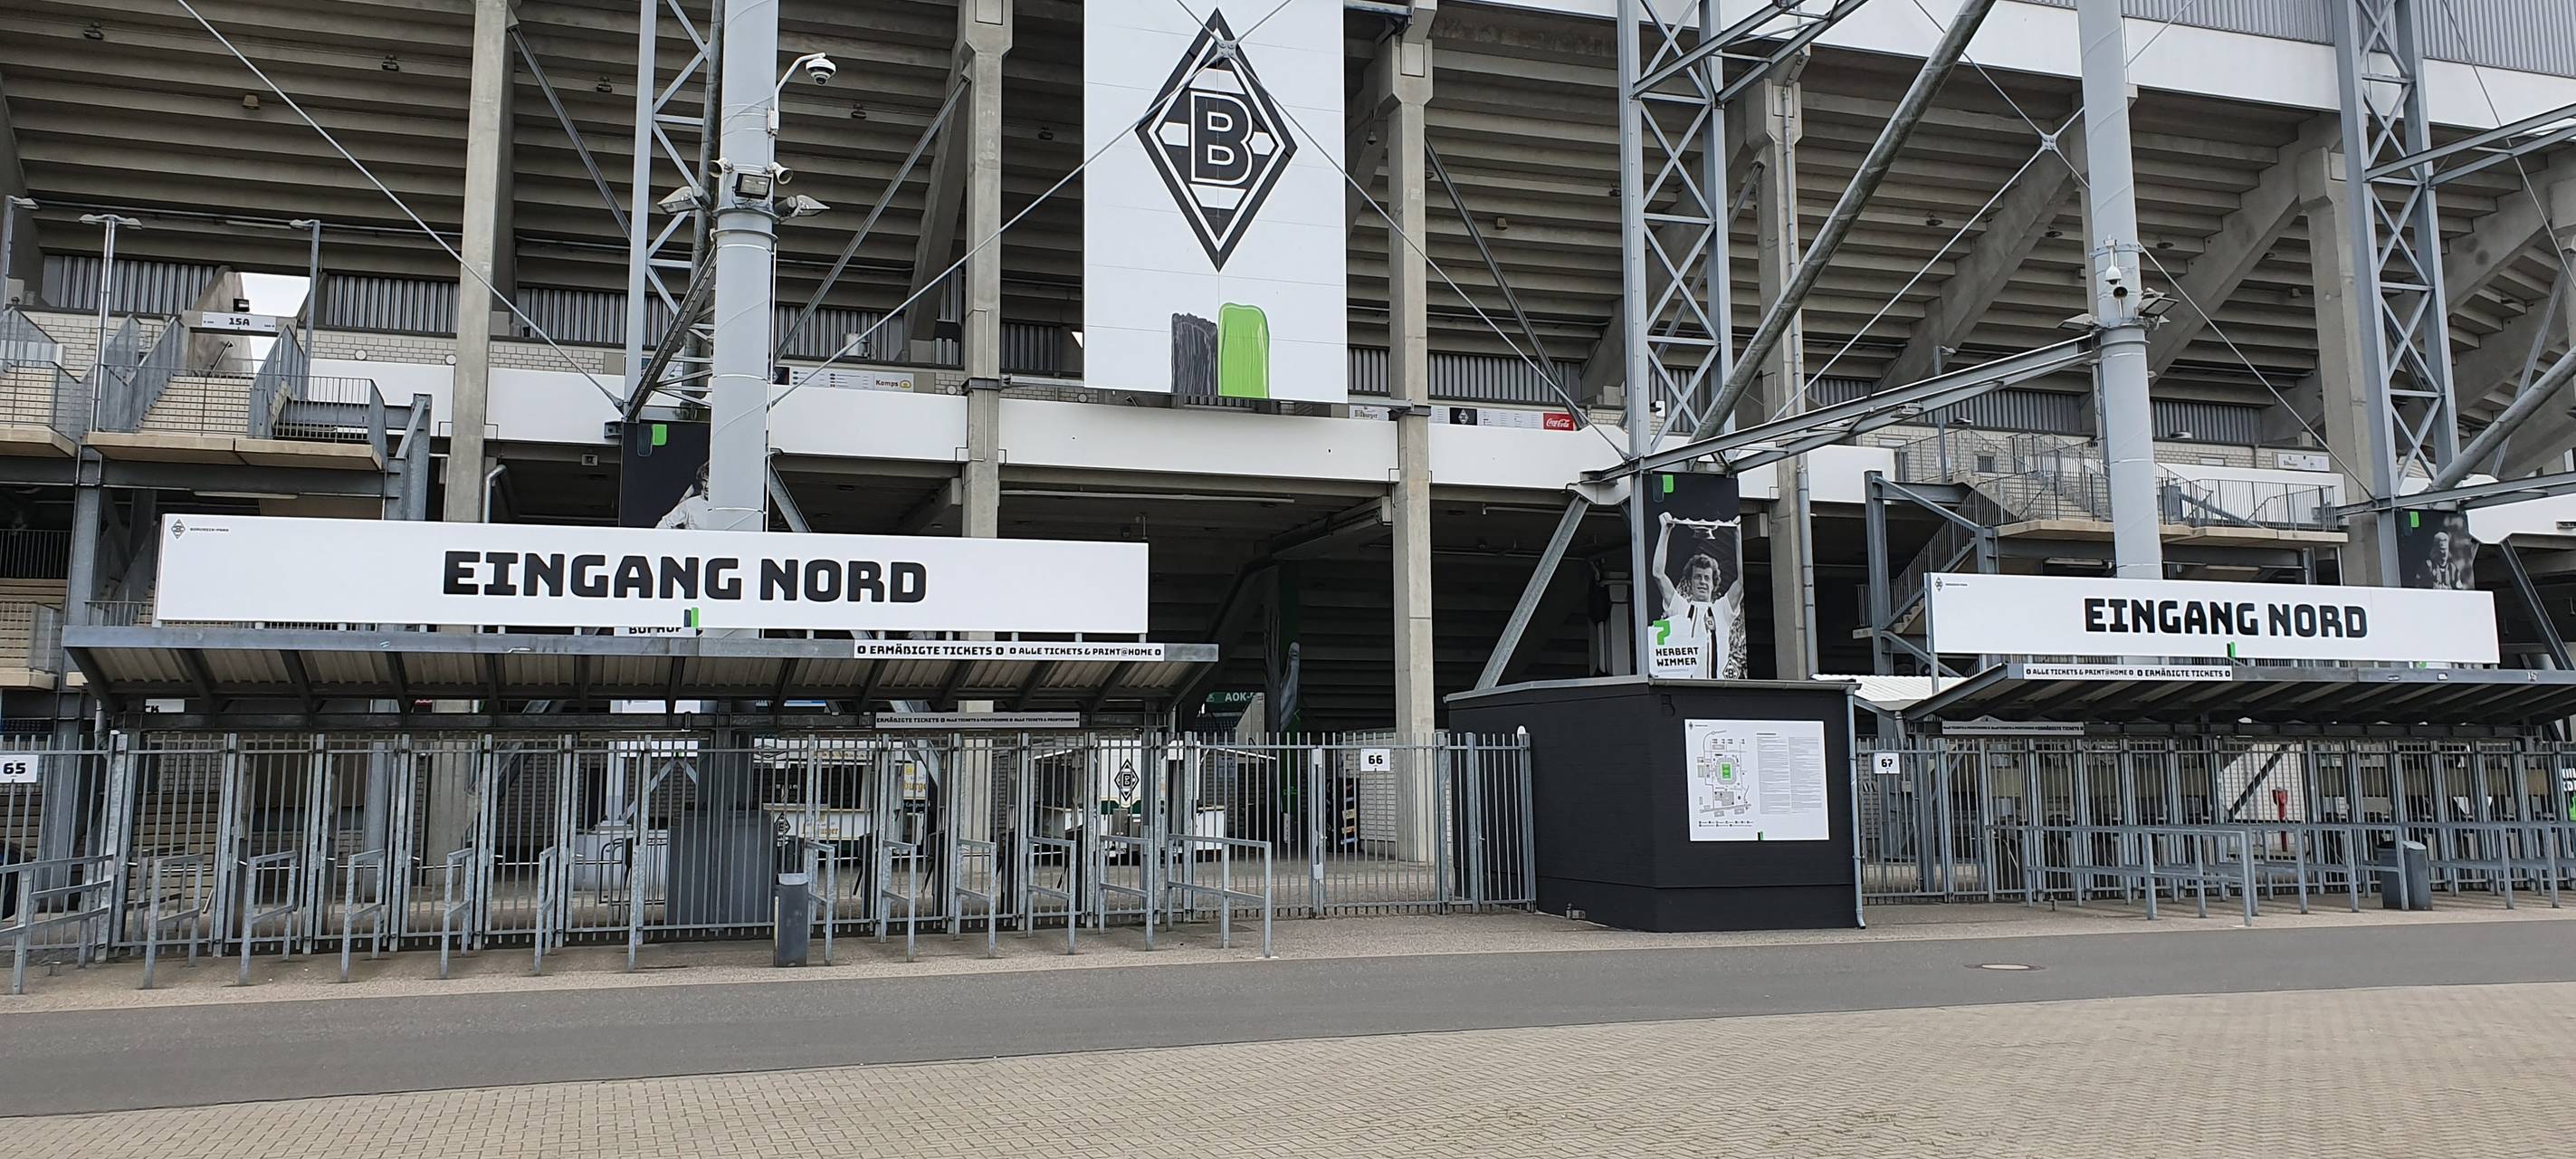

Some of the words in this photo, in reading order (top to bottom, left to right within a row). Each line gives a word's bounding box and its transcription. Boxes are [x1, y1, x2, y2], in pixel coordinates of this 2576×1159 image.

[229, 317, 250, 326] 15A
[444, 551, 742, 600] EINGANG
[760, 559, 927, 604] NORD
[2085, 598, 2259, 636] EINGANG
[2267, 603, 2368, 638] NORD
[942, 646, 993, 656] TICKETS
[1018, 647, 1042, 656] ALLE
[1045, 647, 1083, 656] TICKETS
[1092, 647, 1153, 656] PRINT@HOME
[1655, 647, 1699, 656] HERBERT
[1656, 657, 1697, 667] WIMMER
[1369, 754, 1383, 764] 66
[1882, 758, 1894, 768] 67
[4, 762, 26, 774] 65
